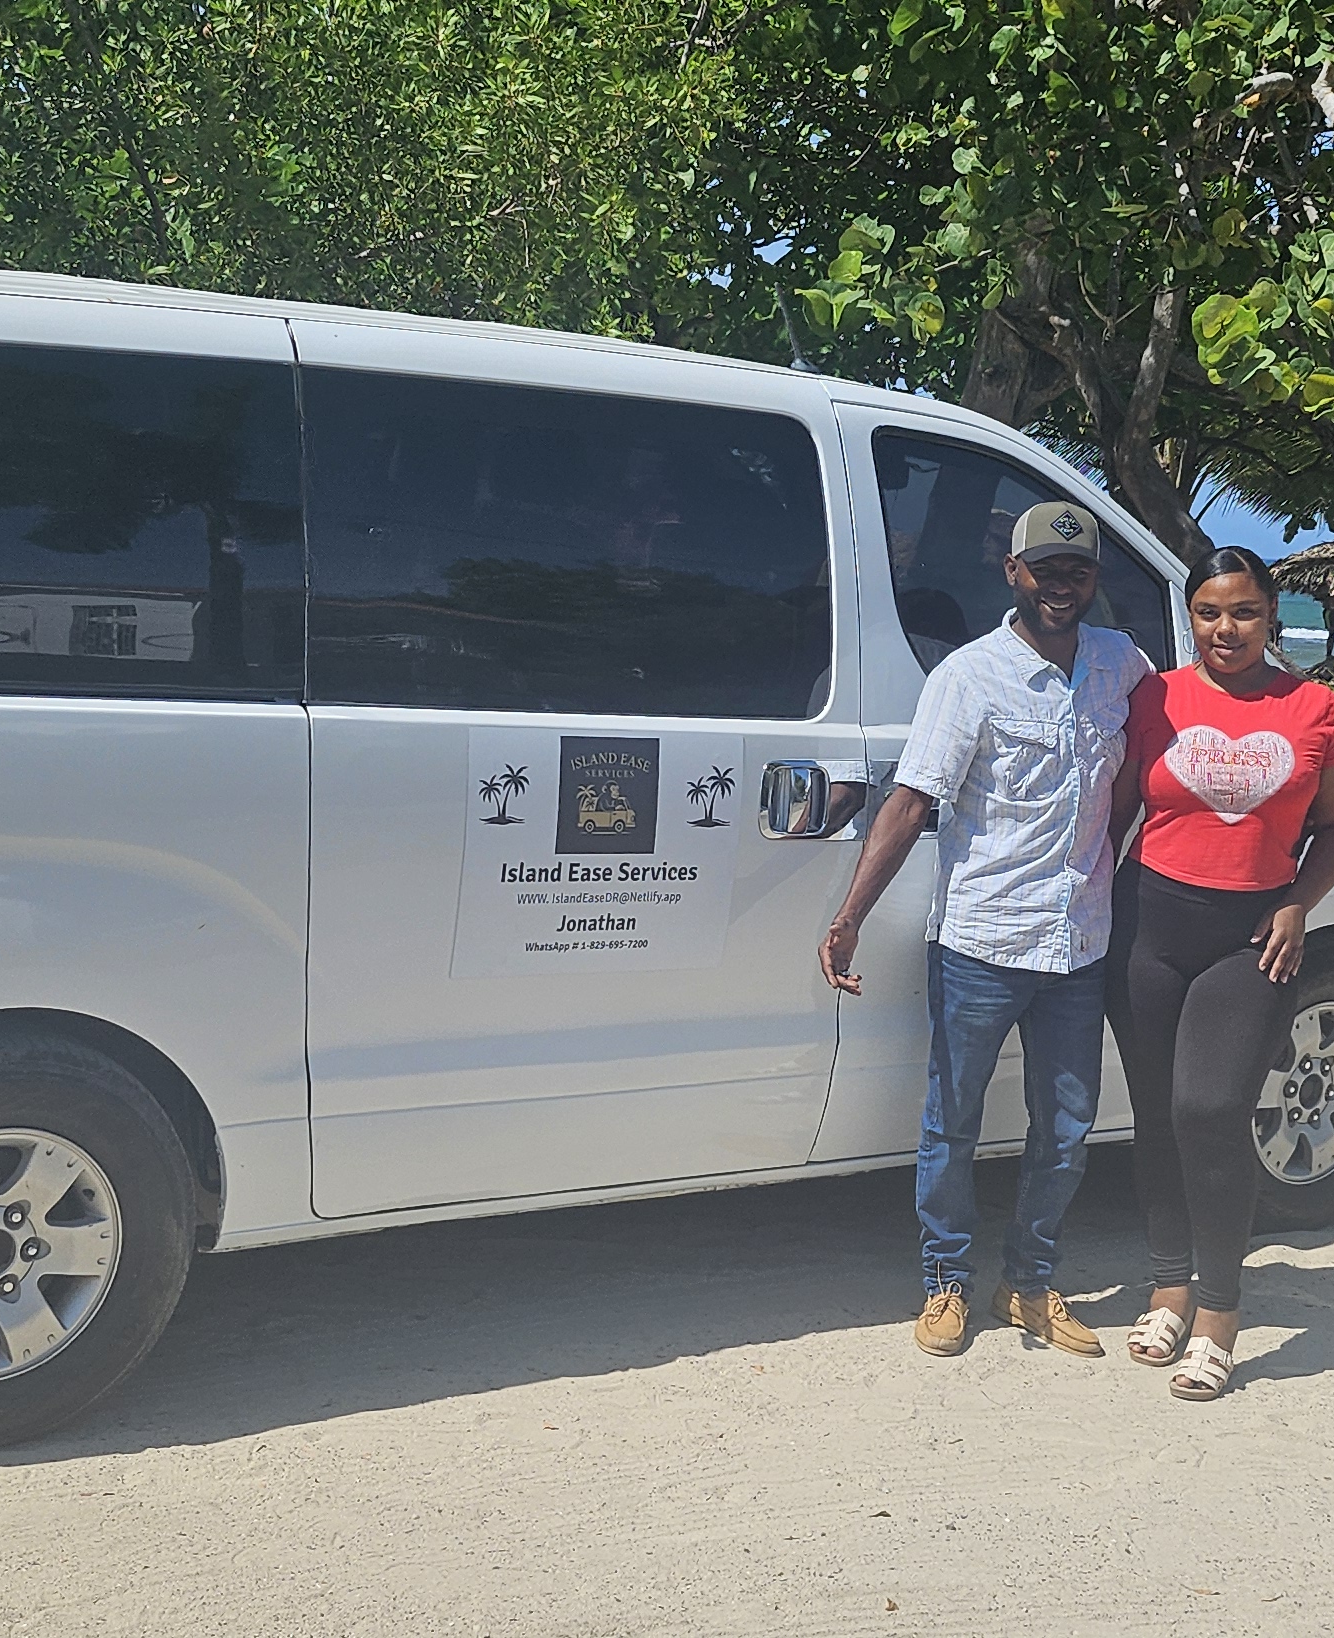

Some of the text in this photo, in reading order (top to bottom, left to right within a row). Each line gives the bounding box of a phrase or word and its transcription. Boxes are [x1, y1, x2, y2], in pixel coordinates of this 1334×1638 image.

[570, 752, 651, 773] ISLAND EASE
[585, 769, 635, 778] SERVICES
[500, 861, 698, 883] Island Ease Services
[552, 890, 682, 905] IslandEaseDR@Netlify.app
[556, 912, 637, 932] Jonathan
[525, 939, 649, 953] WhatsApp # 1-829-695-7200
